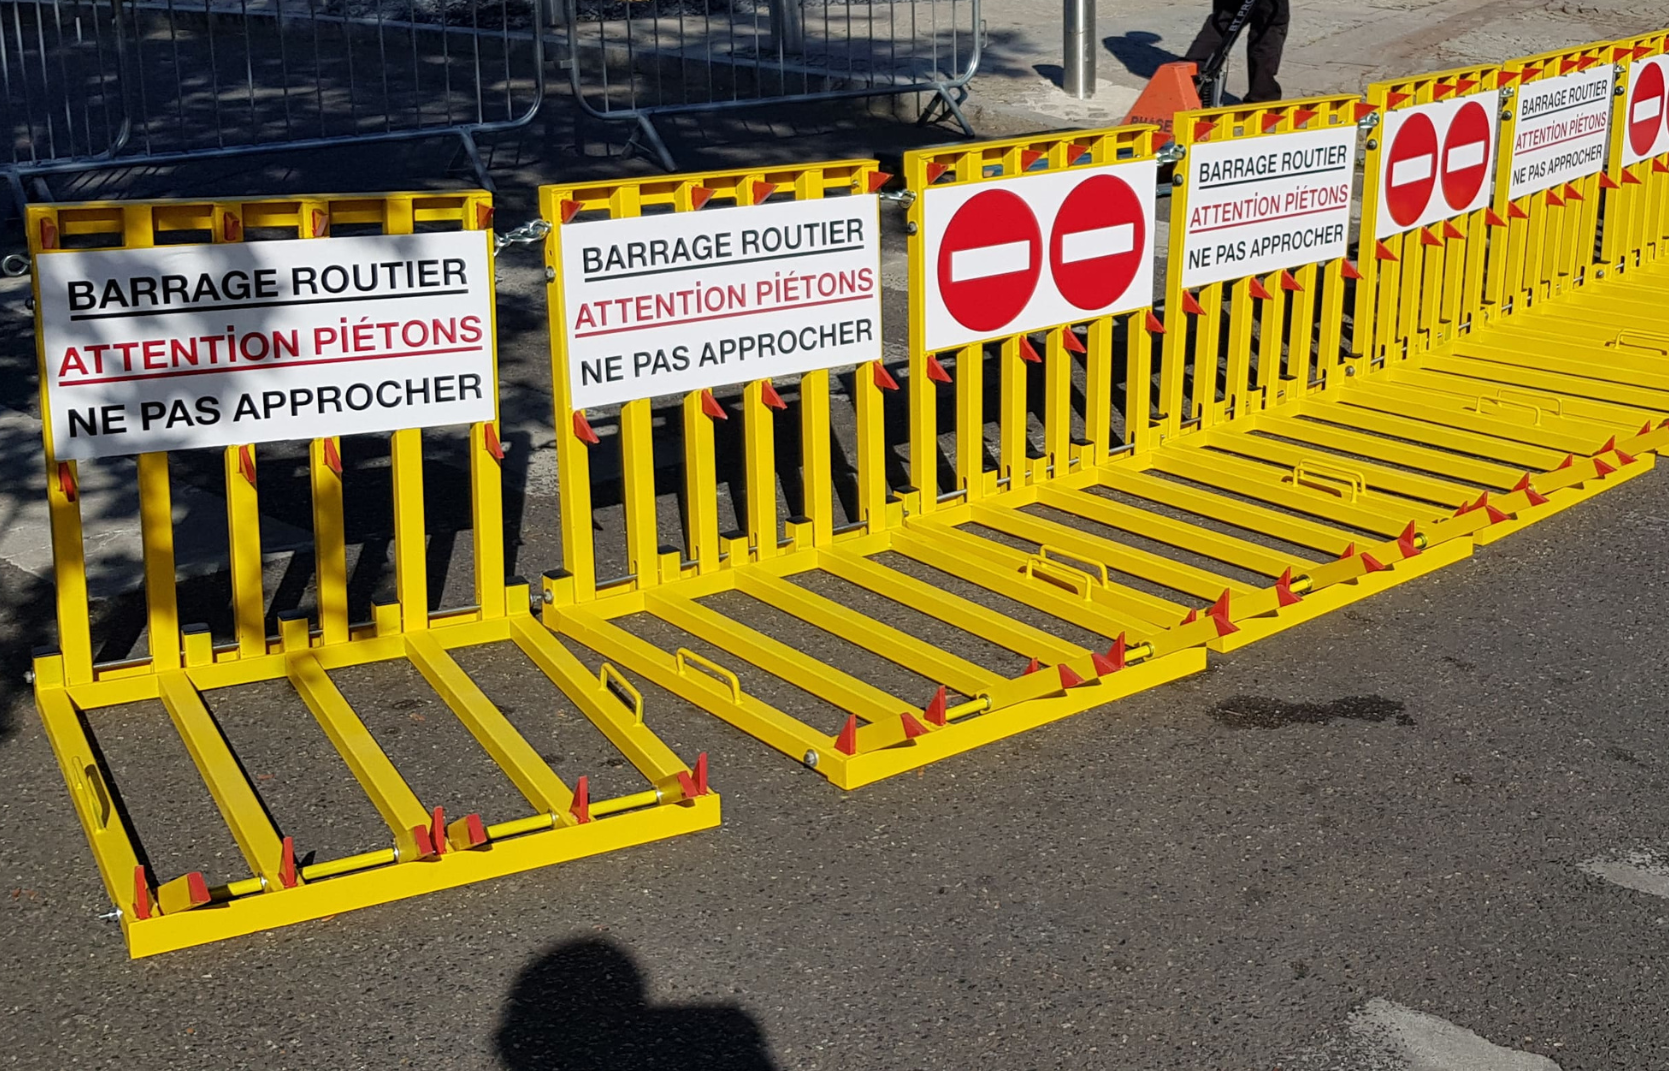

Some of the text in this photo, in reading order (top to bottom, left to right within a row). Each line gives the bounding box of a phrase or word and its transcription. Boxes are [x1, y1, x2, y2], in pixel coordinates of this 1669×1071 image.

[1228, 18, 1241, 31] BT
[1522, 80, 1607, 116] BARRAGE ROUTIER
[1199, 145, 1347, 182] BARRAGE ROUTIER
[1512, 144, 1603, 186] NE PAS APPROCHER
[583, 218, 863, 273] BARRAGE ROUTIER
[1189, 224, 1343, 269] NE PAS APPROCHER
[68, 258, 467, 311] BARRAGE ROUTIER
[582, 318, 872, 386] NE PAS APPROCHER
[68, 373, 482, 438] NE PAS APPROCHER
